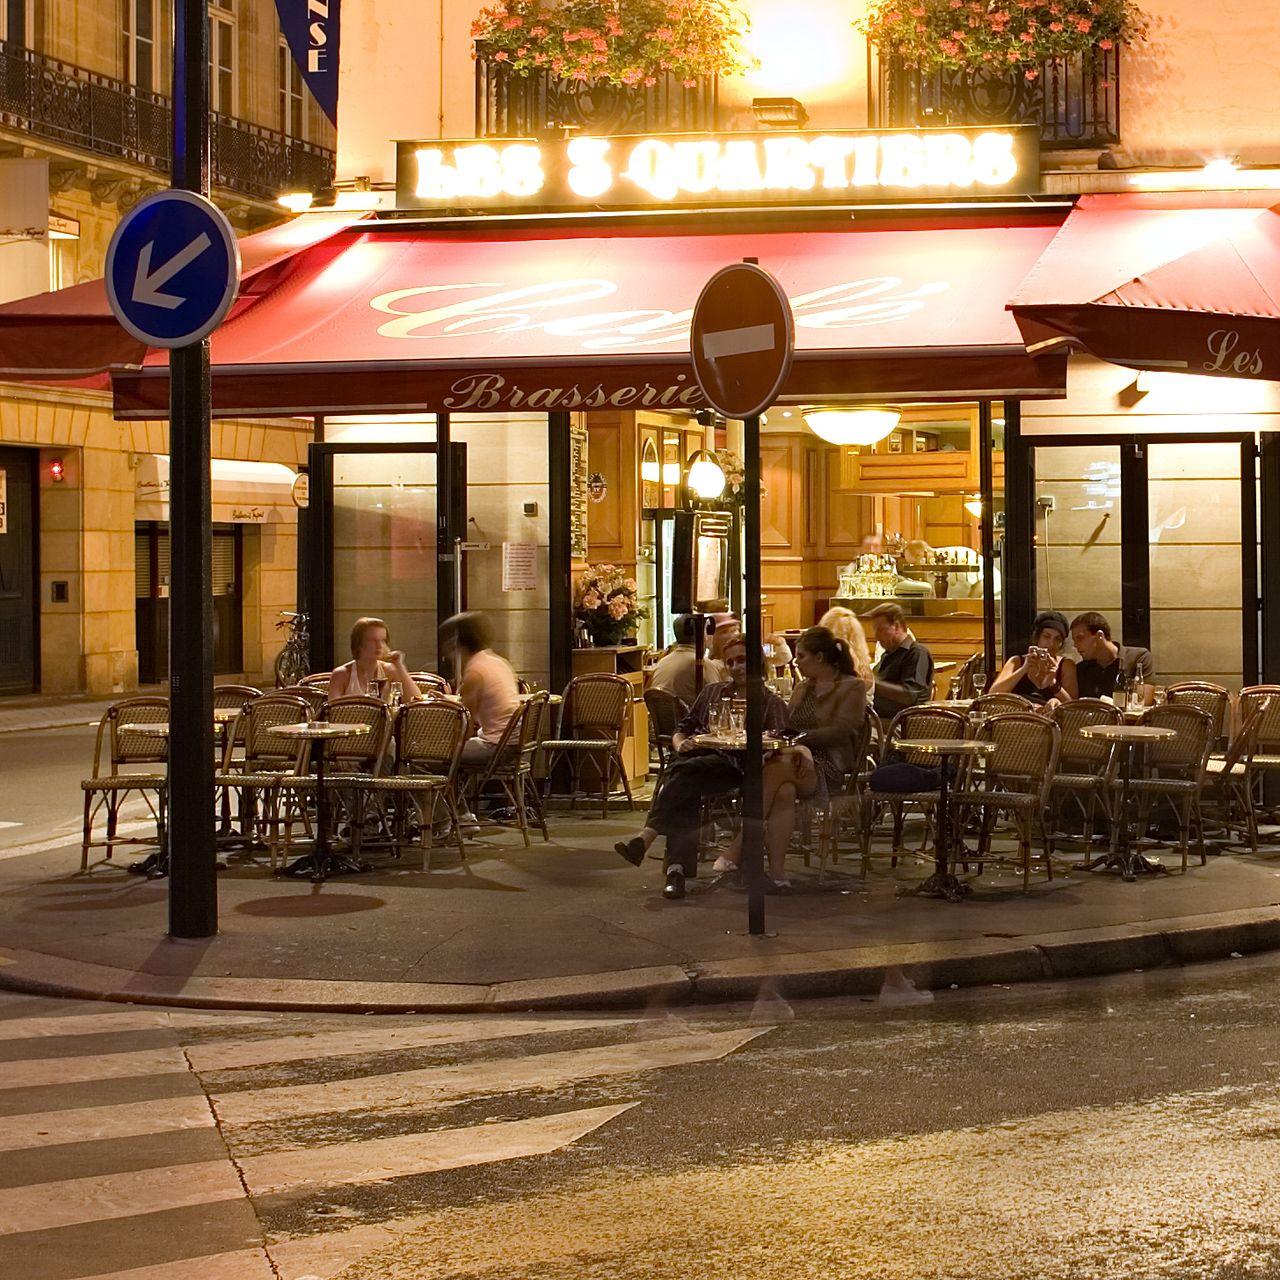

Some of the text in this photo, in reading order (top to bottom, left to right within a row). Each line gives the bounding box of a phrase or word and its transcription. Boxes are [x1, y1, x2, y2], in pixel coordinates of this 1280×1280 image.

[415, 131, 1018, 202] LES 3 QUARTIERS
[1202, 329, 1264, 375] Les
[443, 374, 703, 411] Brasserie
